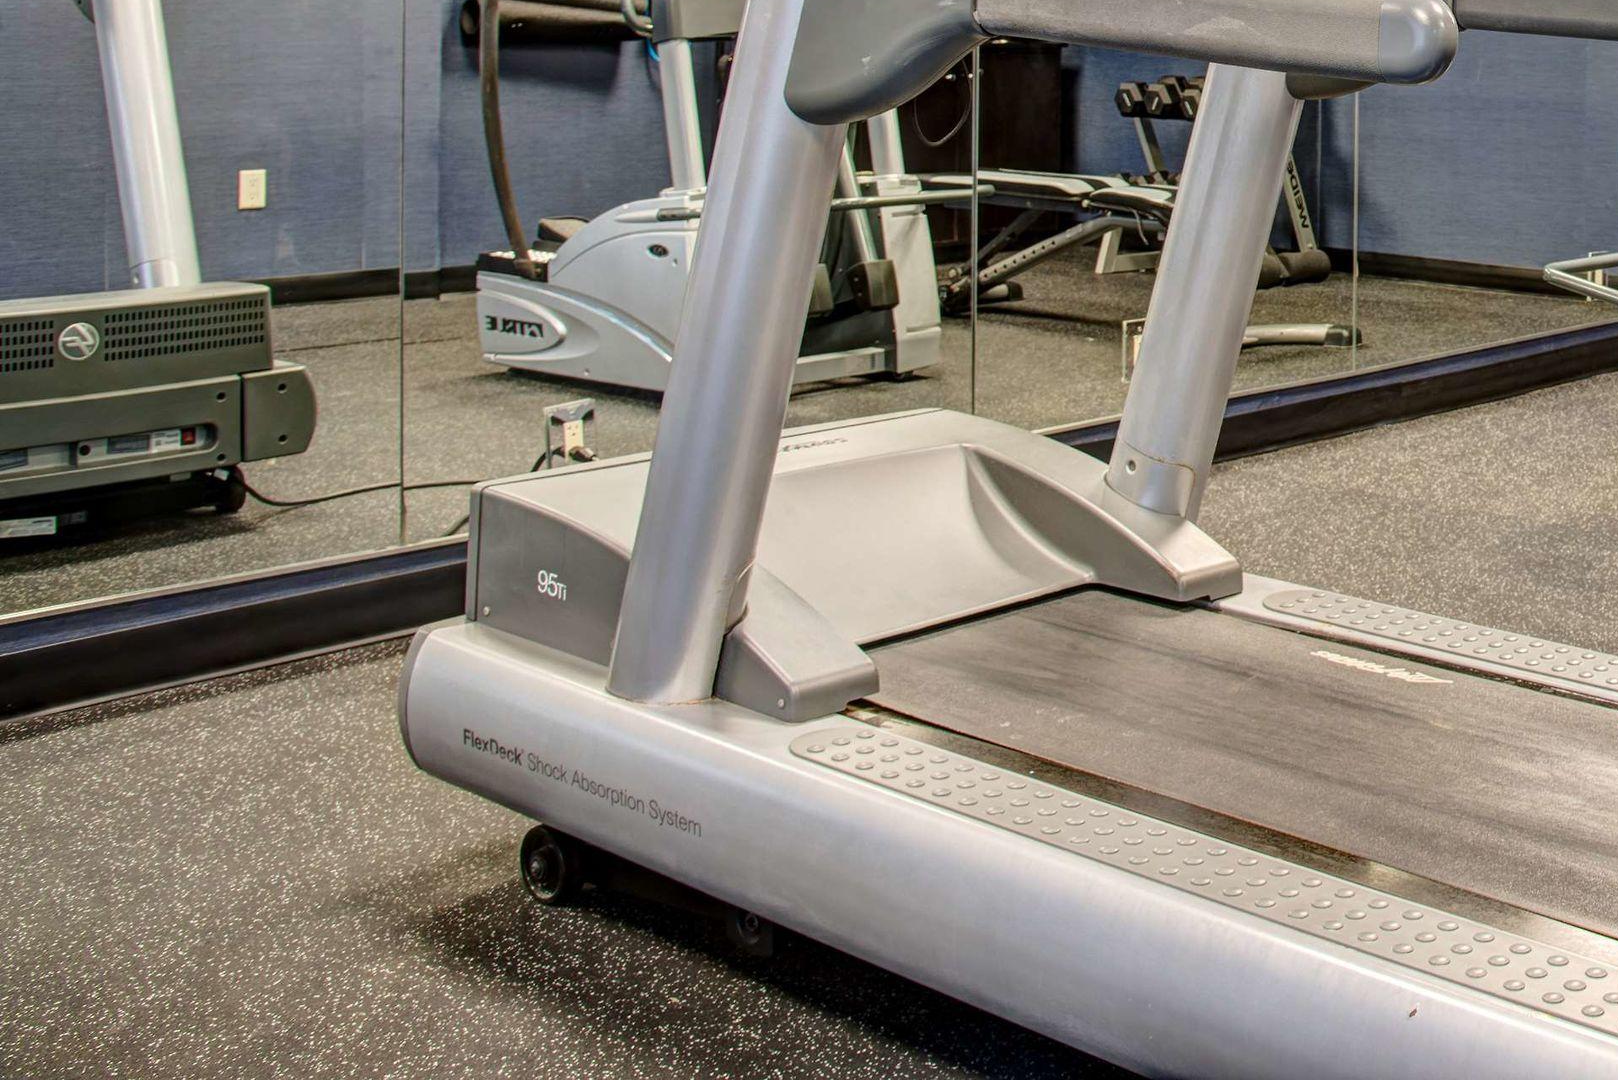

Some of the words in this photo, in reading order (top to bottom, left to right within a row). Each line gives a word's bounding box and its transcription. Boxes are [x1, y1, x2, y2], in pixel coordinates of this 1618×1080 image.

[526, 752, 568, 784] Shock
[571, 769, 645, 814] Absorption
[648, 798, 703, 838] System
